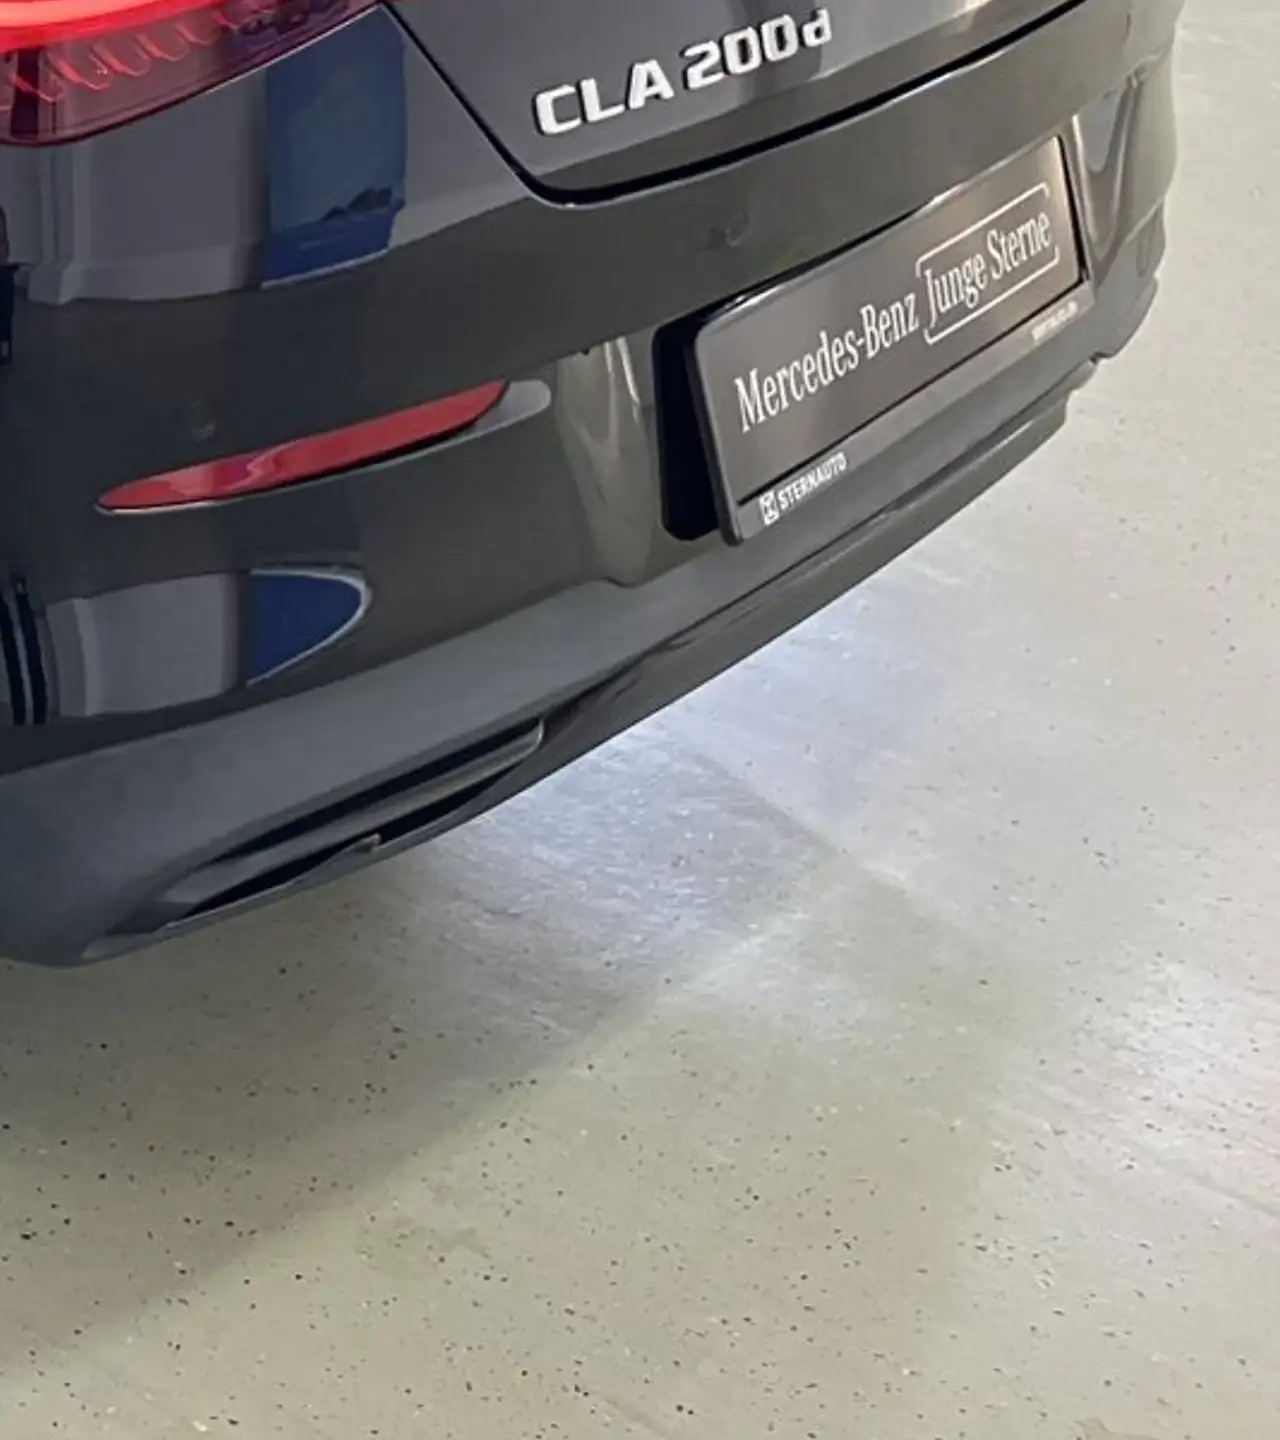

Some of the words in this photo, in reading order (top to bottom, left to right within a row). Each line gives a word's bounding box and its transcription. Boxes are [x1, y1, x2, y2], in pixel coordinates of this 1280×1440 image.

[535, 58, 675, 135] CLA
[733, 291, 921, 434] Mercedes-Benz
[923, 252, 989, 329] Junge
[986, 210, 1053, 281] Sterne
[778, 451, 848, 510] STERNAUTO
